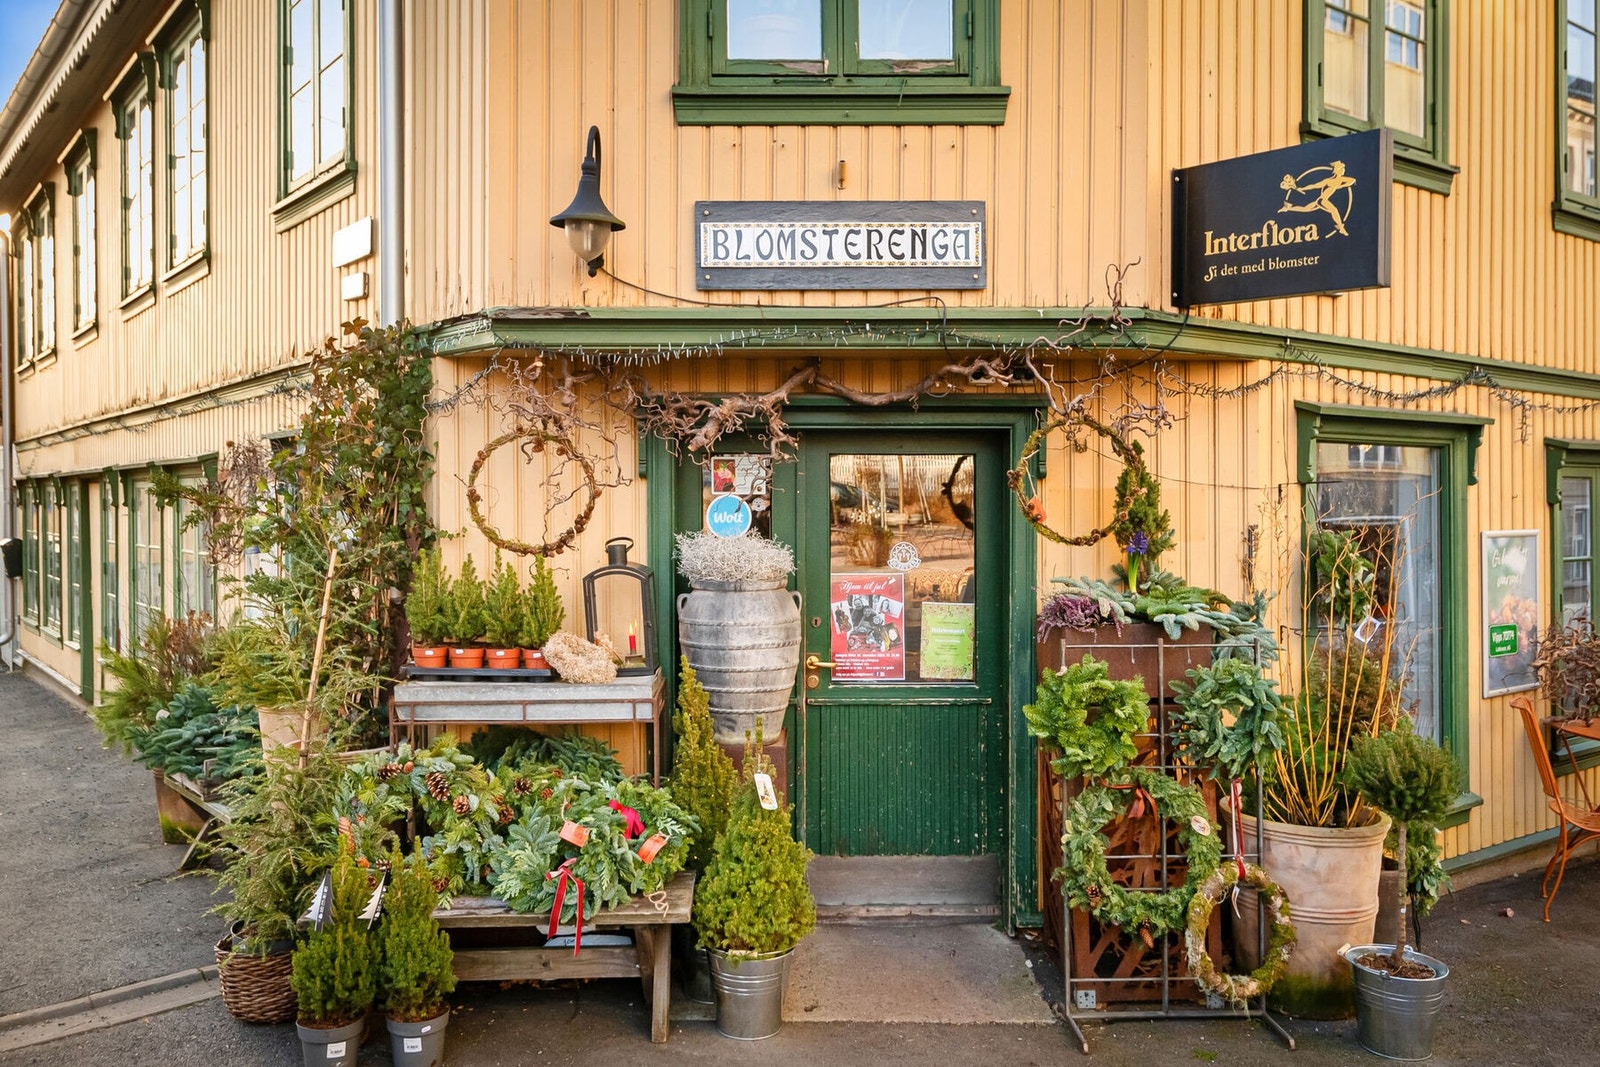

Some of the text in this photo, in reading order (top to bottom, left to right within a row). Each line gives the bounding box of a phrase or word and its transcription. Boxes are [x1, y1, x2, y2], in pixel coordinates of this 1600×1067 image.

[712, 228, 971, 261] BLOMSTERENGA
[1203, 219, 1320, 256] Interflora
[1220, 263, 1238, 277] det
[1241, 259, 1265, 274] med
[1268, 255, 1320, 271] blomster
[713, 511, 744, 524] Wolt
[839, 580, 861, 594] Hjem
